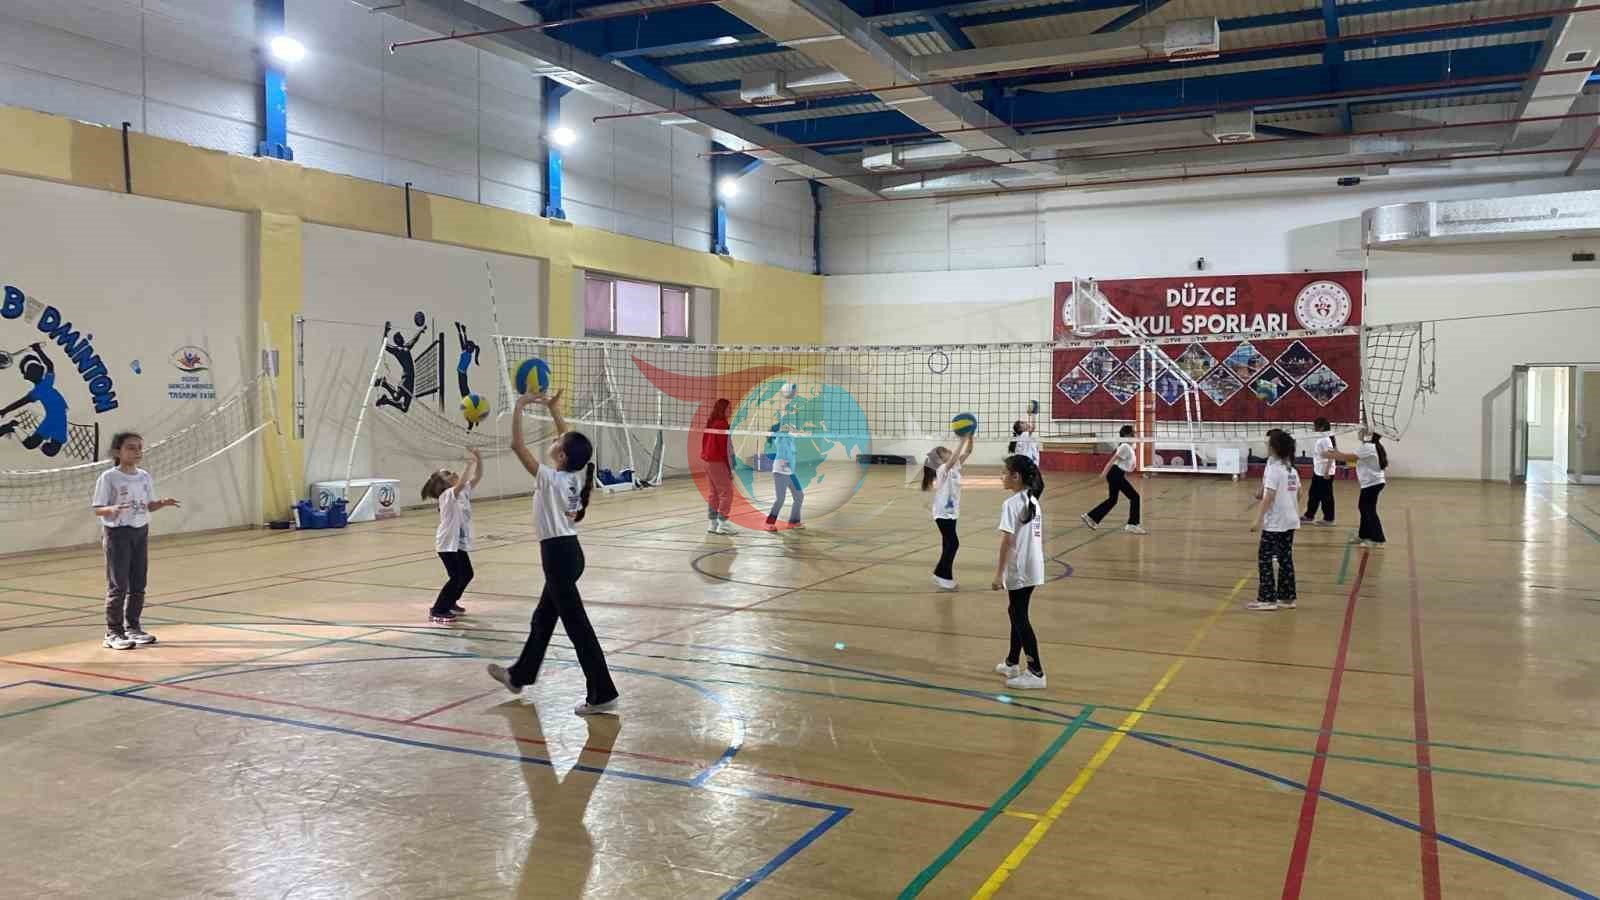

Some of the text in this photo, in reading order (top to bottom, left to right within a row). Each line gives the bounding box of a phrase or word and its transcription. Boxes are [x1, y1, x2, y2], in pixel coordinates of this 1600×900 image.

[1166, 282, 1237, 307] DÜZCE
[1118, 313, 1288, 336] OKUL SPORLARI
